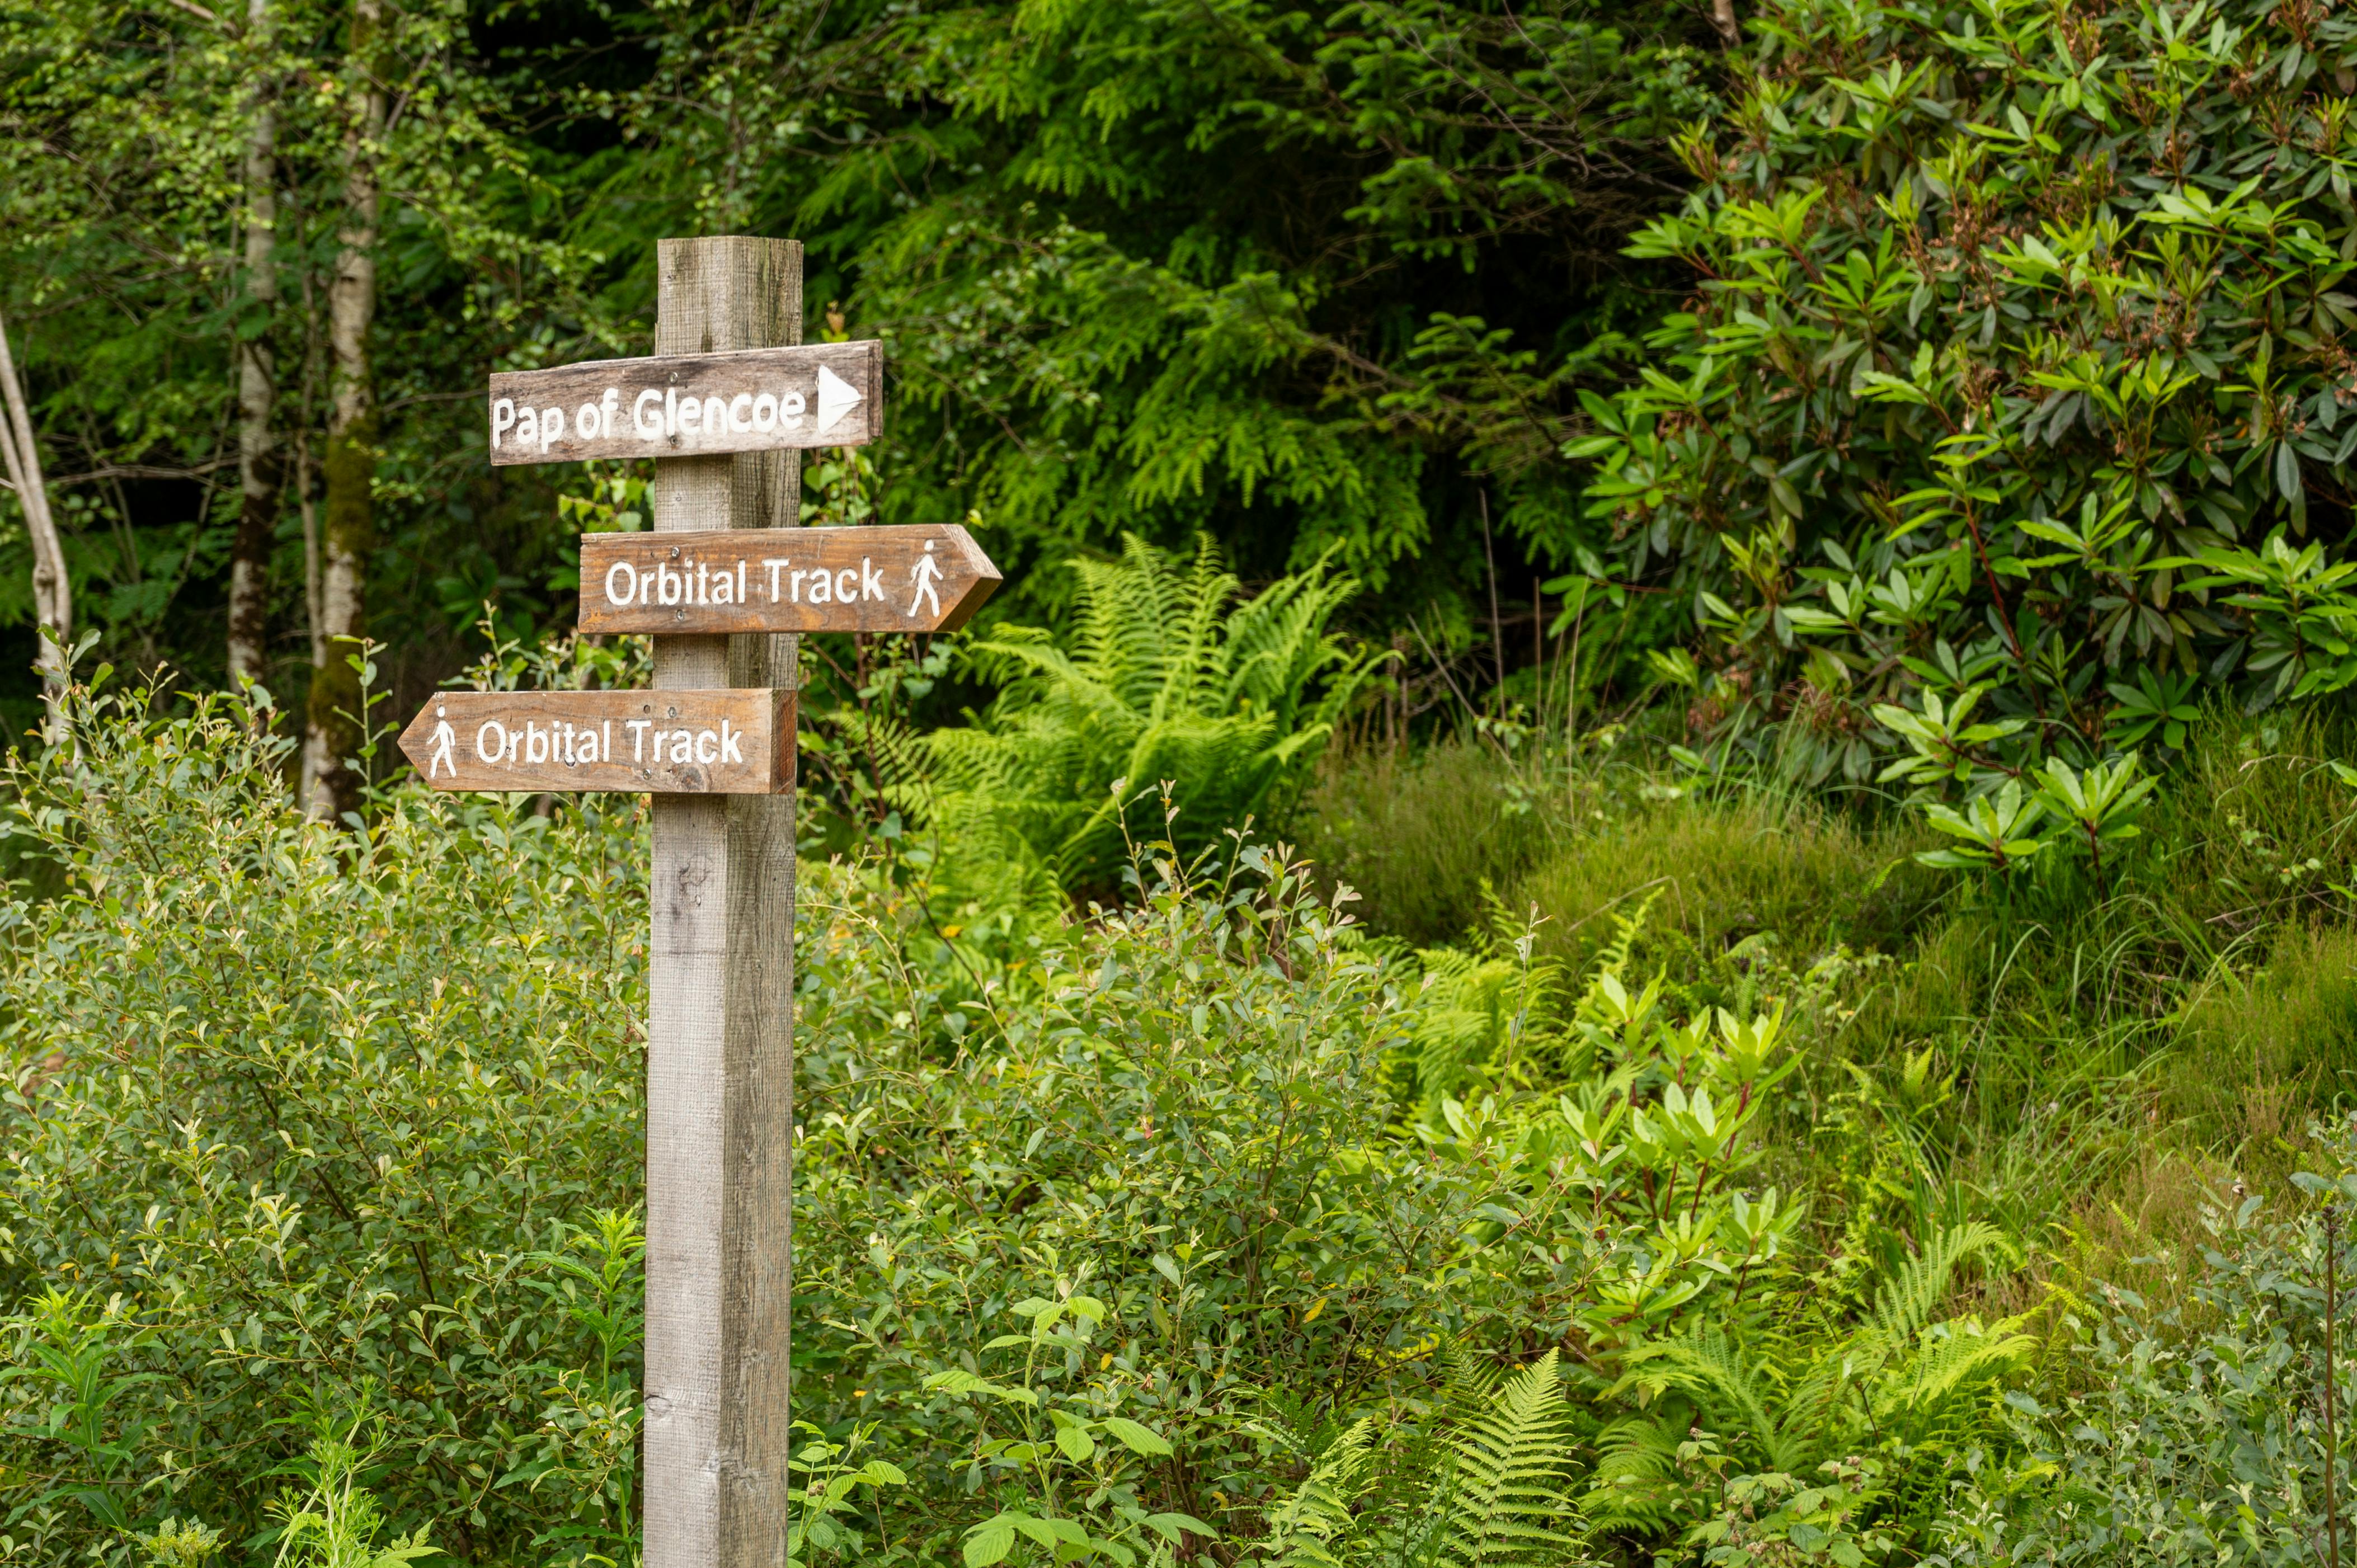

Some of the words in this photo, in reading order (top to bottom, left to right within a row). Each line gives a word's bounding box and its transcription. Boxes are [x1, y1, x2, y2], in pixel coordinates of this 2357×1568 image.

[492, 398, 565, 454] Pap
[576, 387, 619, 440] of
[633, 387, 806, 440] Glencoe
[605, 557, 746, 606] Orbital
[761, 555, 886, 604] Track
[477, 719, 610, 764] Orbital
[625, 719, 743, 764] Track
